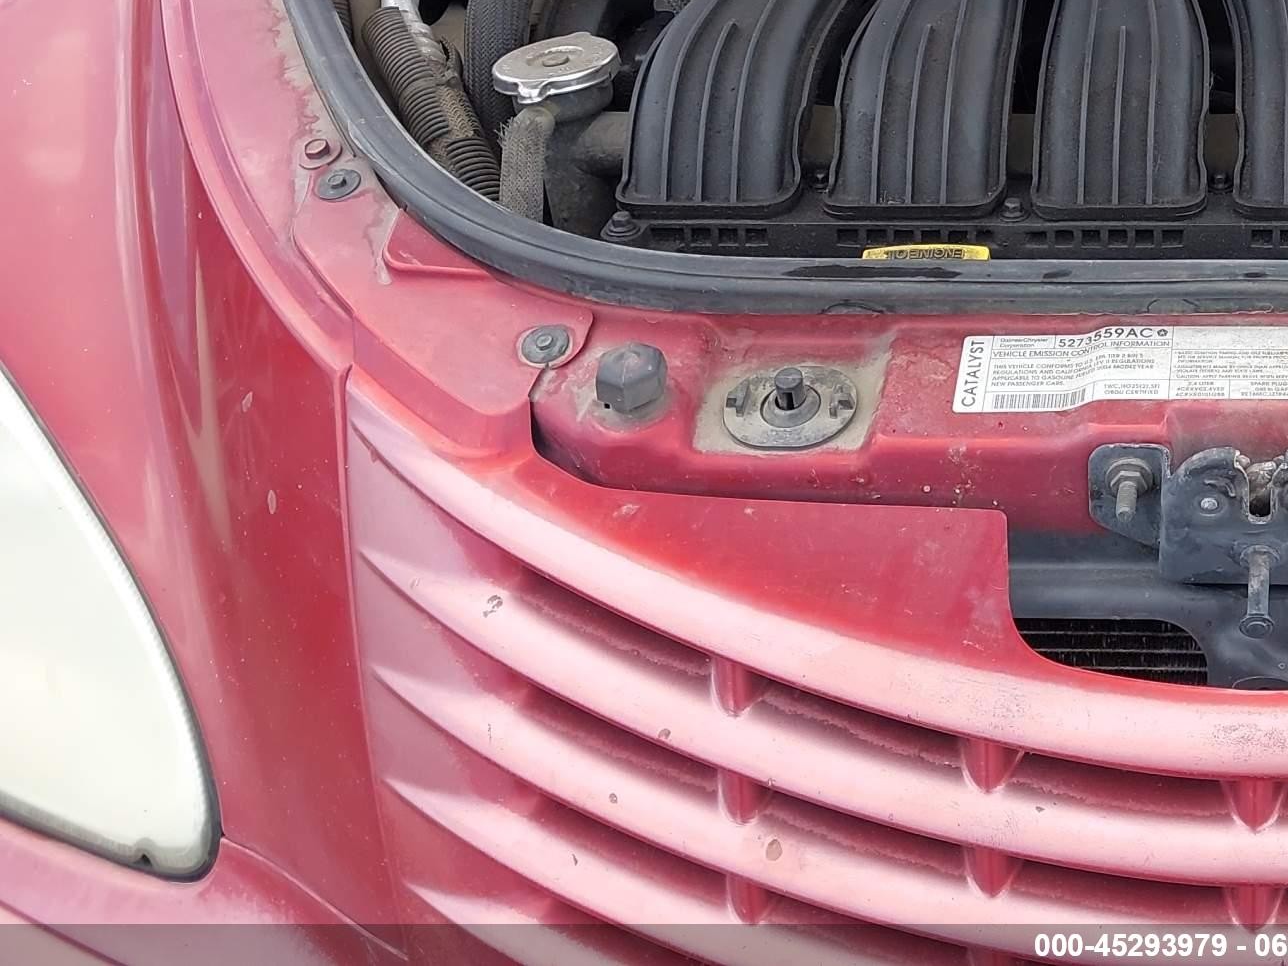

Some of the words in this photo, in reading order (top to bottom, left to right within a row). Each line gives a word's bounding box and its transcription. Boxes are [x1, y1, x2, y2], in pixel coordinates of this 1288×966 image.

[908, 248, 965, 260] ENGINE
[1058, 327, 1154, 348] 5273559AC
[1071, 342, 1107, 357] CONTROL
[961, 339, 985, 407] CATALYST
